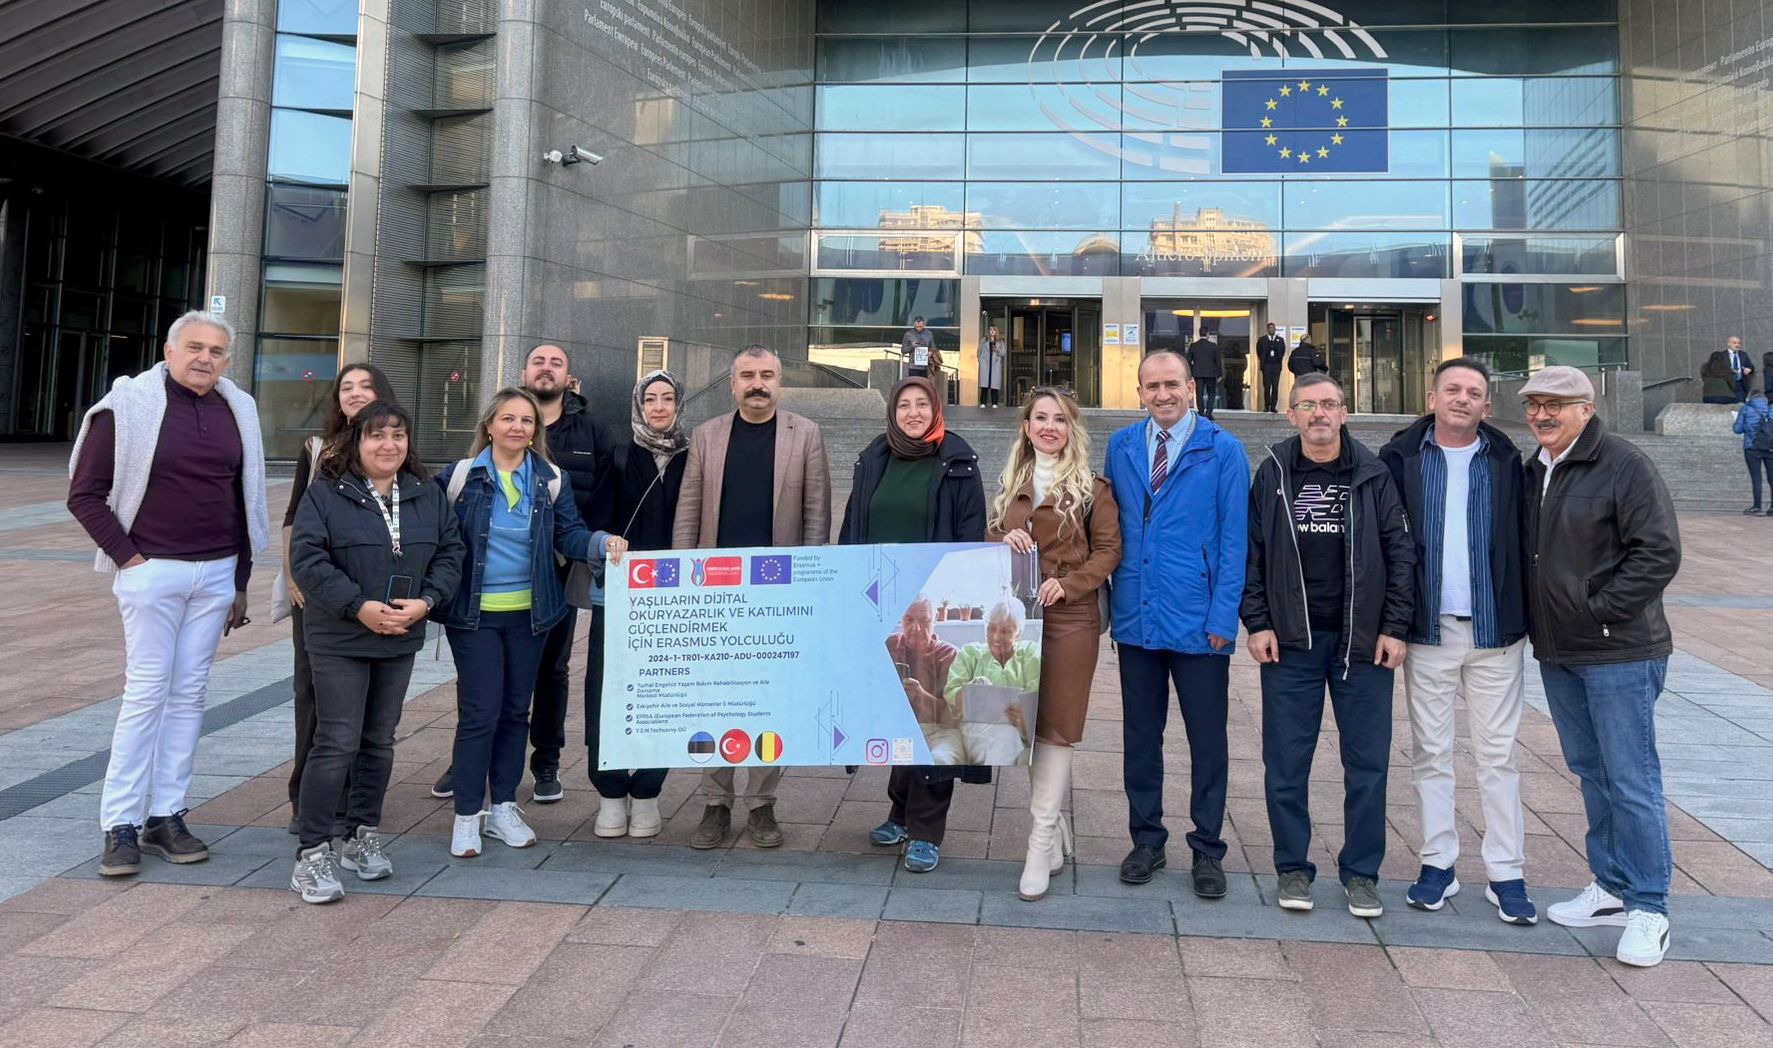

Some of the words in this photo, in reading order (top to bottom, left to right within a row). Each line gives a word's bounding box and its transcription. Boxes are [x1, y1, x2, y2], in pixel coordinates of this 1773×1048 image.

[584, 8, 614, 36] Parlament
[1756, 37, 1773, 52] Europ
[1310, 521, 1345, 533] balan
[629, 595, 700, 608] YAŞLILARIN
[704, 592, 748, 605] DİJİTAL
[629, 608, 725, 621] OKURYAZARLIK
[729, 608, 745, 618] VE
[748, 606, 813, 618] KATILIMINI
[628, 622, 728, 636] GÜÇLENDİRMEK
[628, 637, 652, 652] İÇİN
[656, 637, 717, 648] ERASMUS
[720, 634, 794, 647] YOLCULUĞU
[648, 651, 800, 663] 2024-1-TR01-KA210-ADU-000247197
[639, 667, 691, 677] PARTNERS
[717, 711, 747, 719] Psychology
